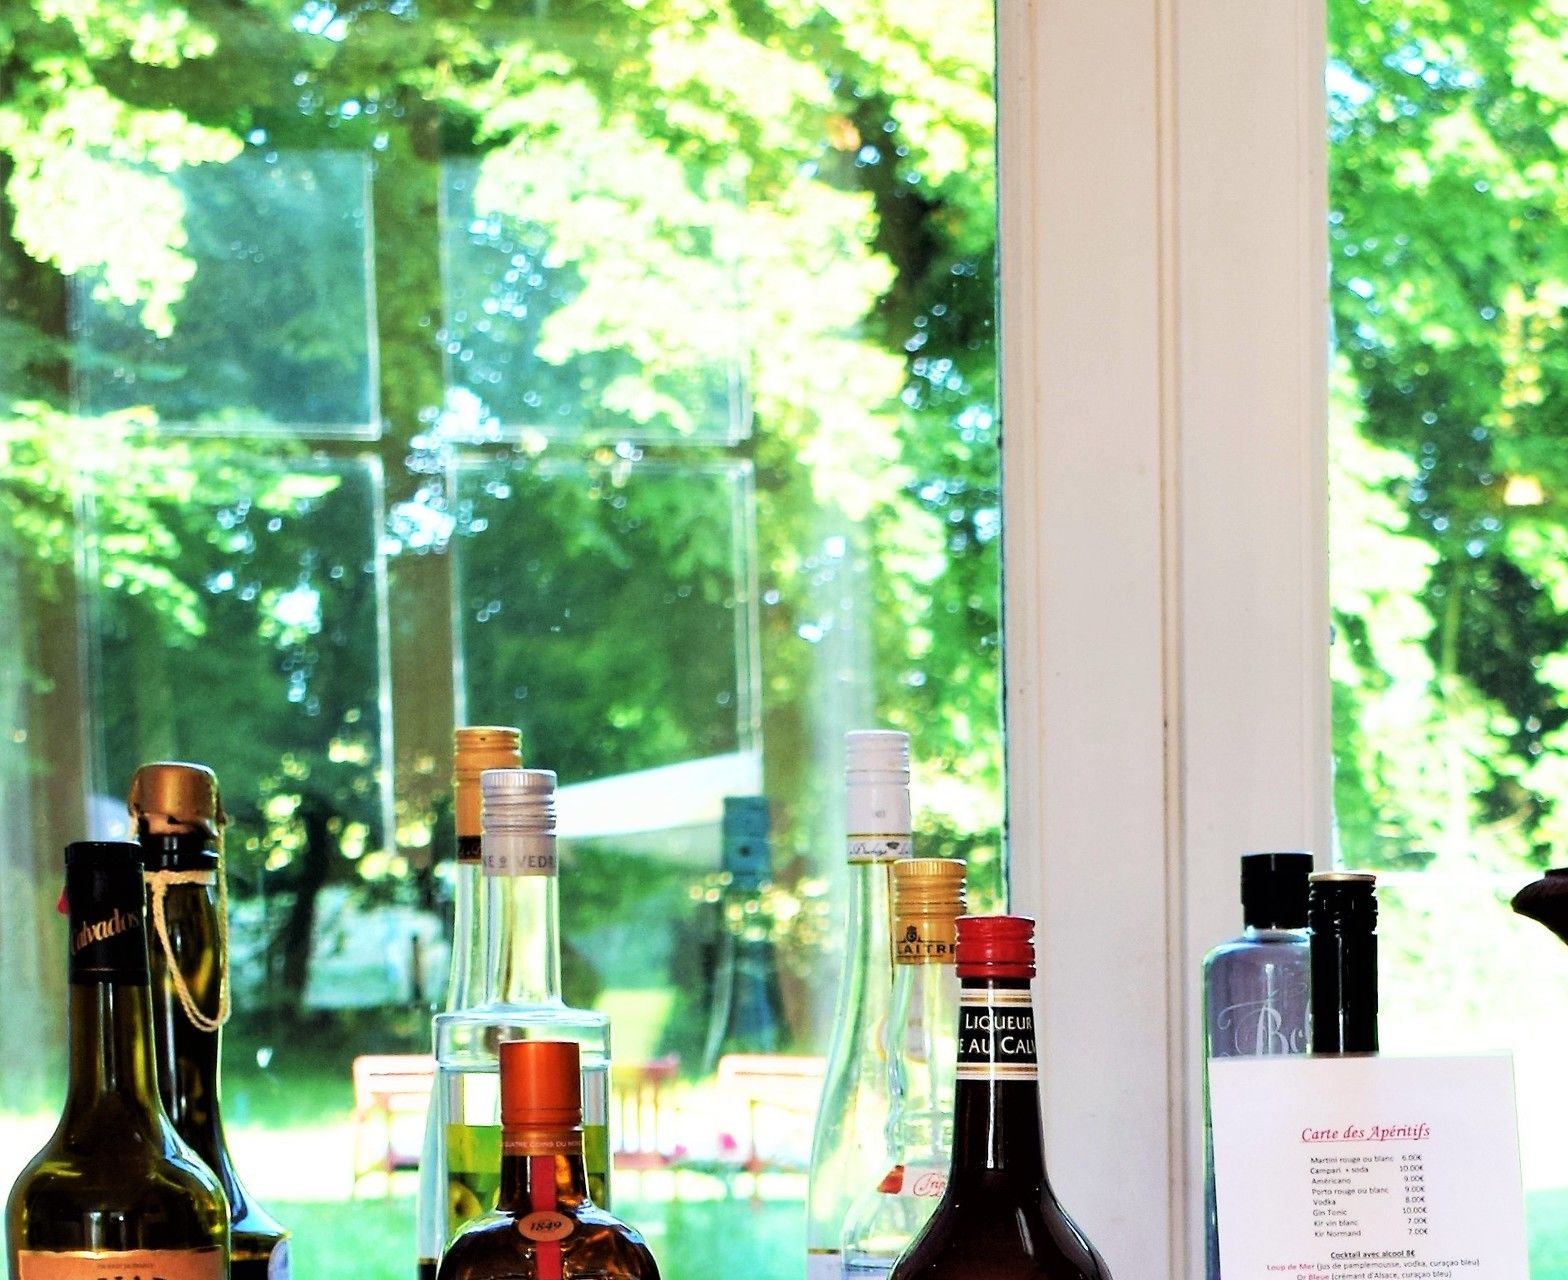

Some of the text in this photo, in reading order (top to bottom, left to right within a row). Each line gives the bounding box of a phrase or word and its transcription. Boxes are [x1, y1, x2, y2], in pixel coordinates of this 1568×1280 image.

[965, 1013, 1032, 1033] LIQUEUR
[1302, 1123, 1430, 1142] Carte des Apéritifs
[1310, 1167, 1341, 1175] Campari
[530, 1221, 561, 1233] 1849
[1330, 1251, 1361, 1259] Cocktail
